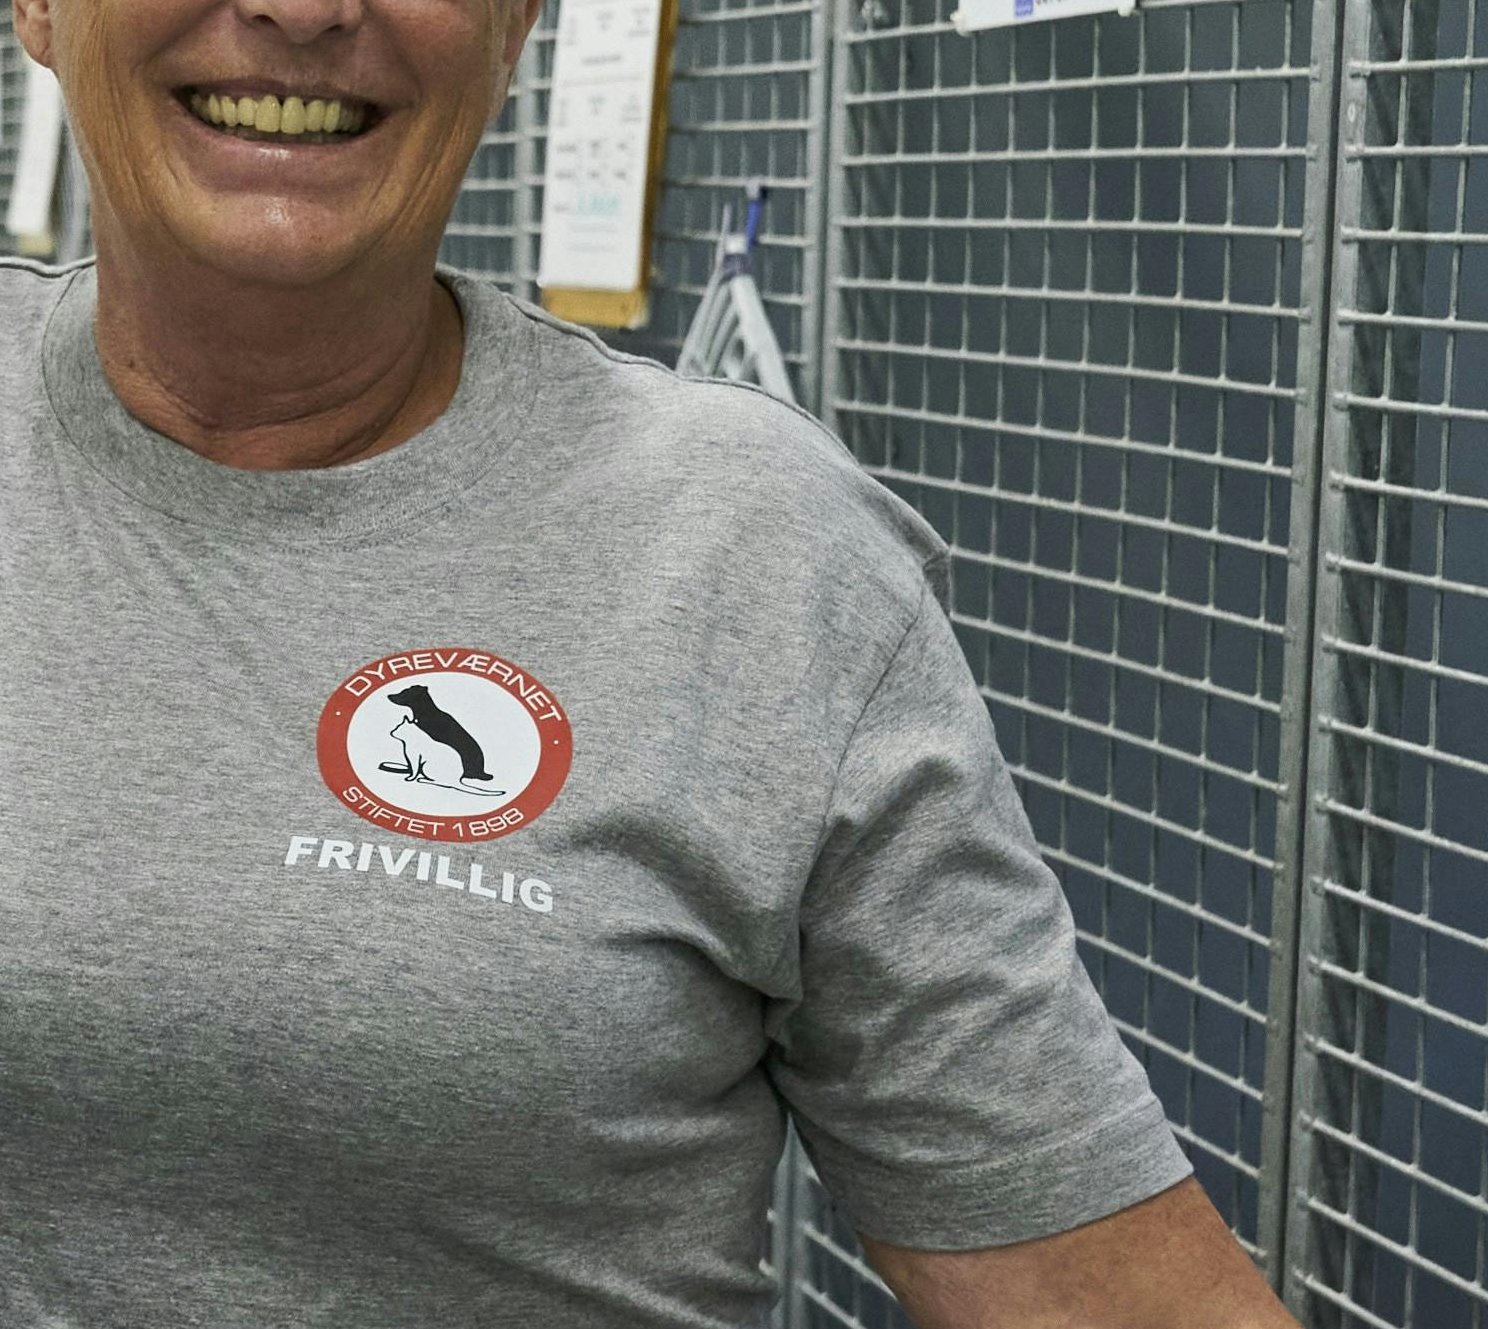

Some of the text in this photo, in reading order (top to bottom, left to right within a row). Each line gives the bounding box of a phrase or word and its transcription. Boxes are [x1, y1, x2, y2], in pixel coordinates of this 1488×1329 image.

[345, 651, 562, 724] DYREVÆRNET
[342, 785, 524, 838] STIFTET 1898
[284, 835, 555, 913] FRIVILLIG
